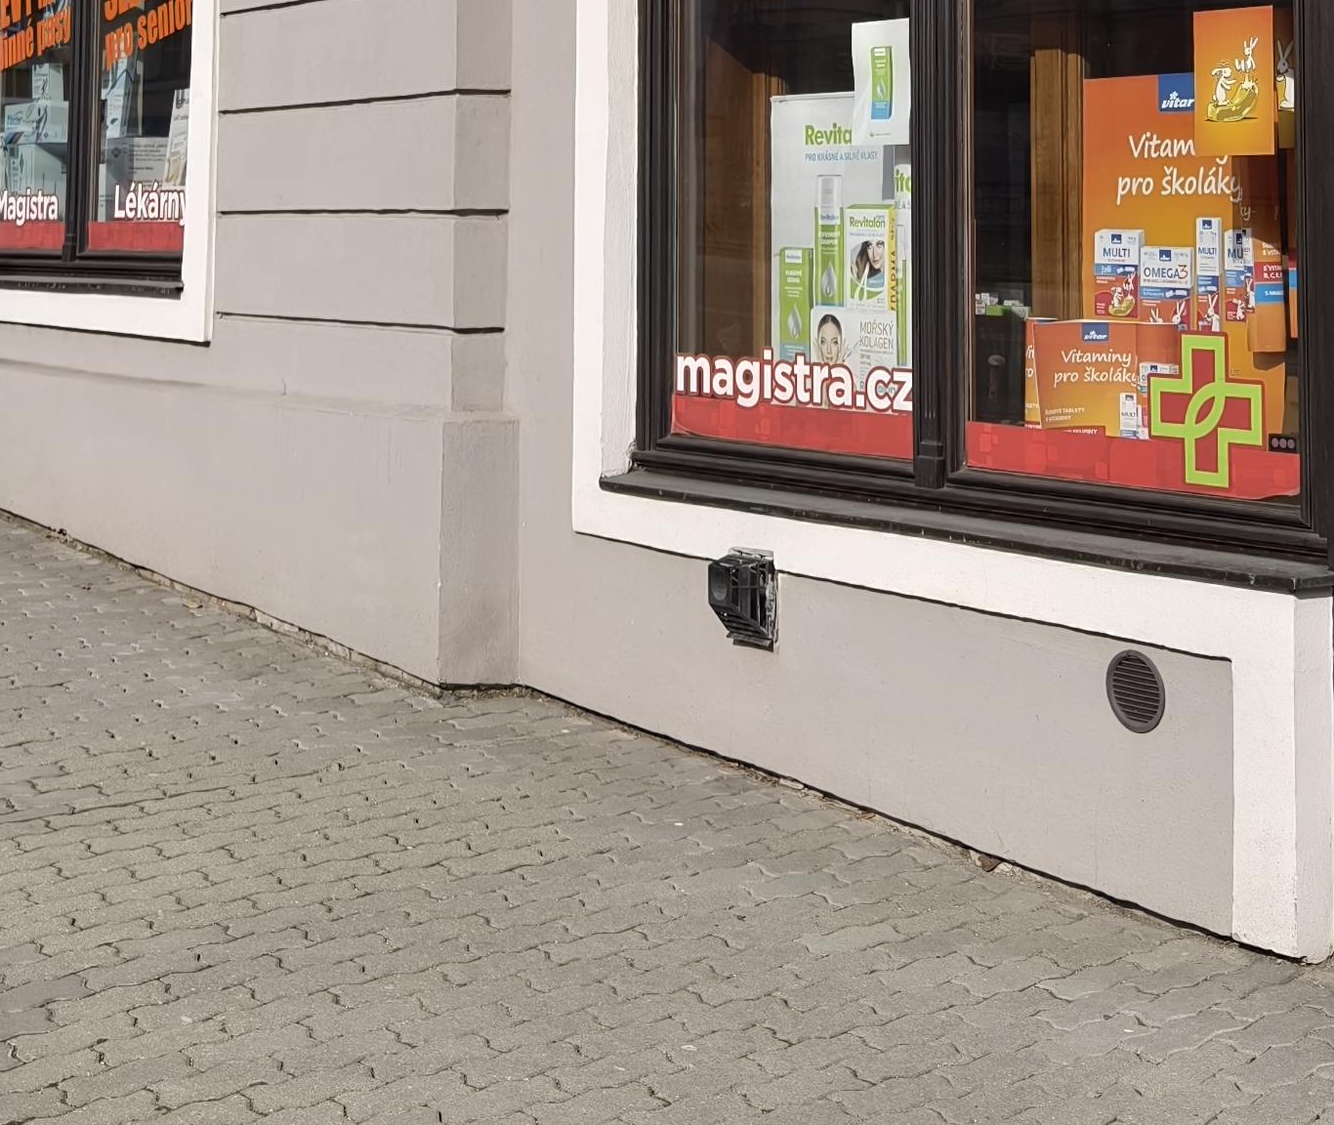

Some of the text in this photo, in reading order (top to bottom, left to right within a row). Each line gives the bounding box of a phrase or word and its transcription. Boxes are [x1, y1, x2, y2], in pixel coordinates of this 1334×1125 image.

[37, 6, 72, 57] pasy
[105, 22, 134, 72] pro
[1161, 91, 1195, 109] vitar
[804, 123, 852, 145] Revita
[805, 152, 816, 162] PRO
[1117, 165, 1242, 205] pro školáky
[1102, 247, 1131, 258] MULTI
[1198, 246, 1217, 255] MULTI
[859, 319, 894, 335] MOŘSKÝ
[1083, 331, 1108, 340] vitar
[859, 335, 894, 350] KOLAGEN
[1061, 348, 1132, 367] Vitaminy
[676, 348, 913, 412] magistra.cz
[1053, 366, 1138, 388] pro školáky
